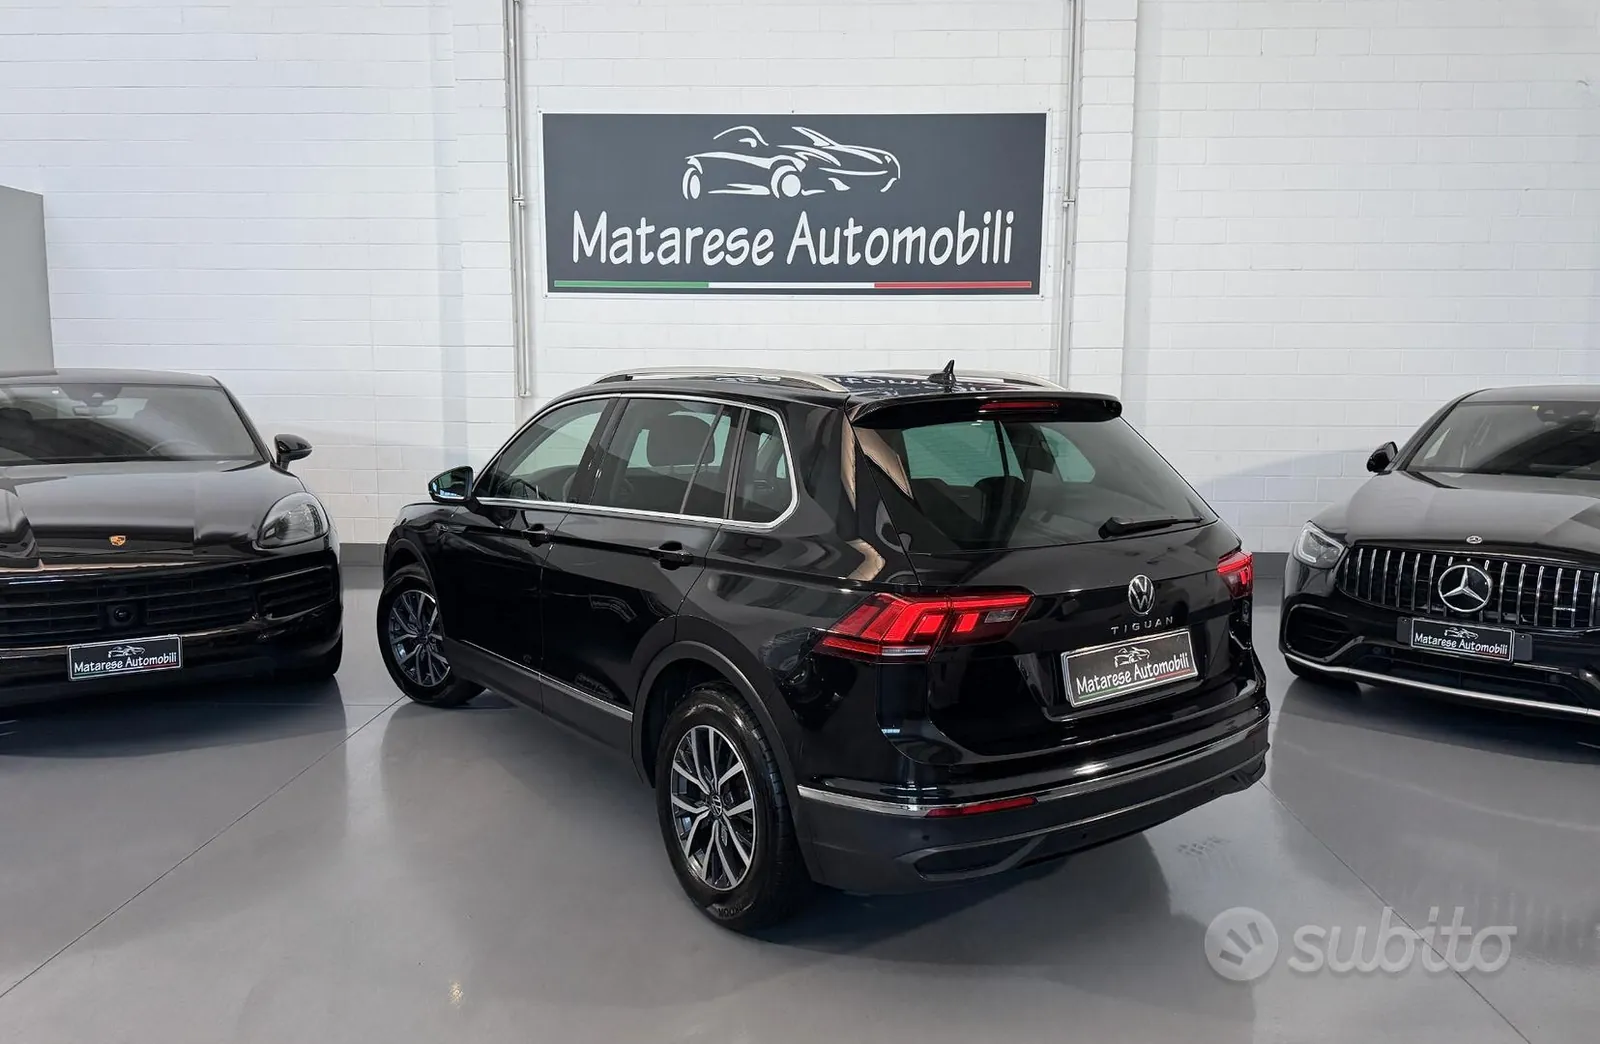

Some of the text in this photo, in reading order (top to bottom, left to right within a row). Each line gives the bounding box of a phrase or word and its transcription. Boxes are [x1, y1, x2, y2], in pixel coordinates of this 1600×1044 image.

[573, 209, 1015, 266] Matarese Automobili
[1110, 616, 1174, 635] TIGUAN
[1414, 632, 1508, 655] Matarese Automobili
[74, 652, 177, 673] Matarese Automobili
[1076, 652, 1190, 695] Matarese Automobili
